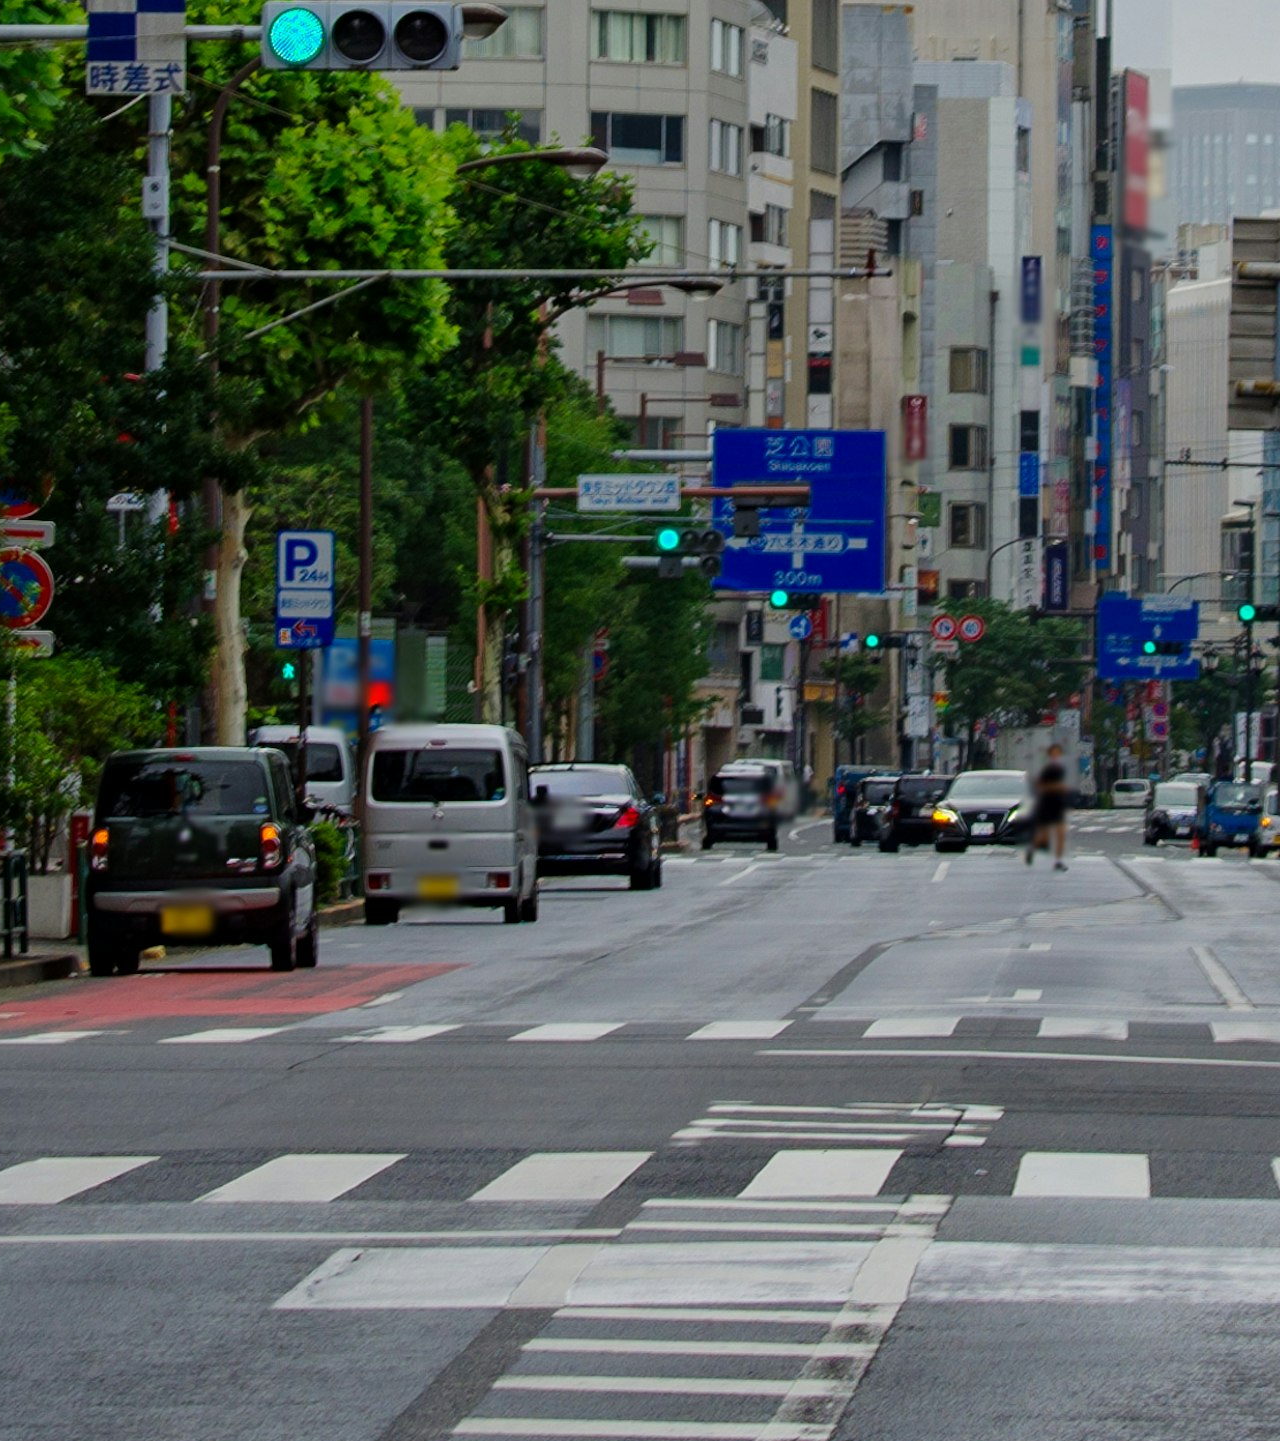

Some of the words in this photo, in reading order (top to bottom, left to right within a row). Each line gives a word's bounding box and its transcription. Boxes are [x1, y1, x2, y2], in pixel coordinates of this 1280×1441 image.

[90, 62, 183, 92] 時差式
[765, 436, 834, 457] 芝公園
[285, 538, 318, 582] P
[774, 571, 823, 586] 300m
